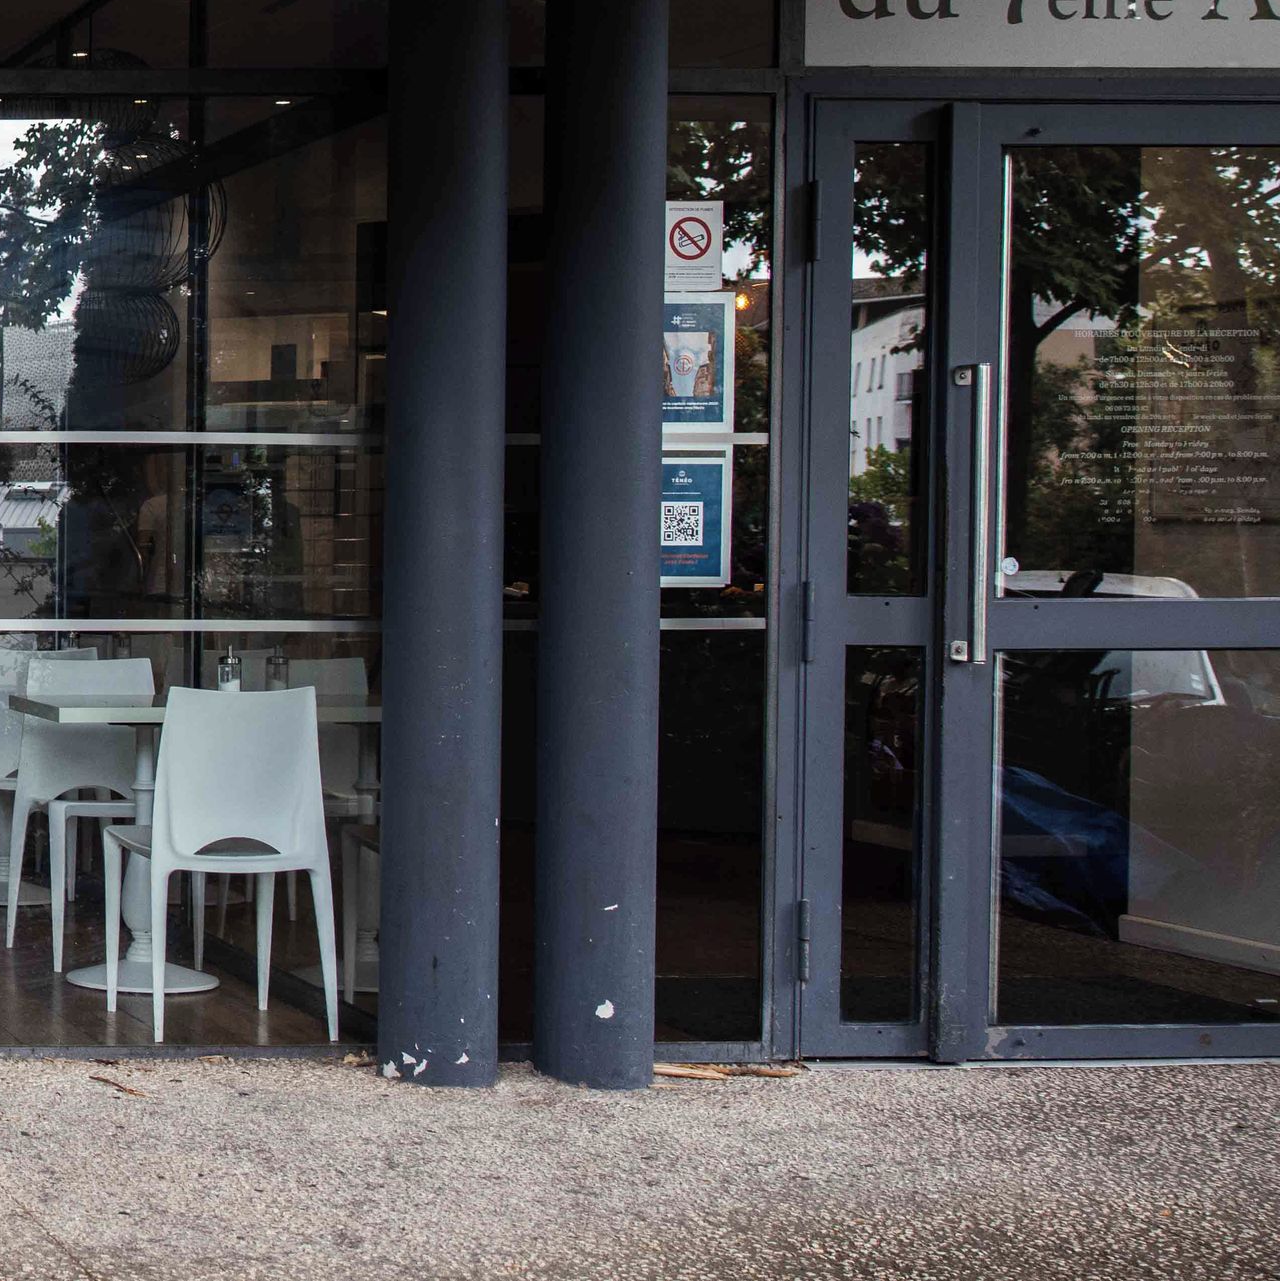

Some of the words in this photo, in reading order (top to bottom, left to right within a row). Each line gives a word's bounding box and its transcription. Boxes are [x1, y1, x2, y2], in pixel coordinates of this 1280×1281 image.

[1075, 328, 1119, 338] HORAIRES
[1183, 328, 1196, 338] DE
[1196, 328, 1209, 338] LA
[1121, 425, 1161, 433] OPENING
[1161, 425, 1212, 433] RECEPTION
